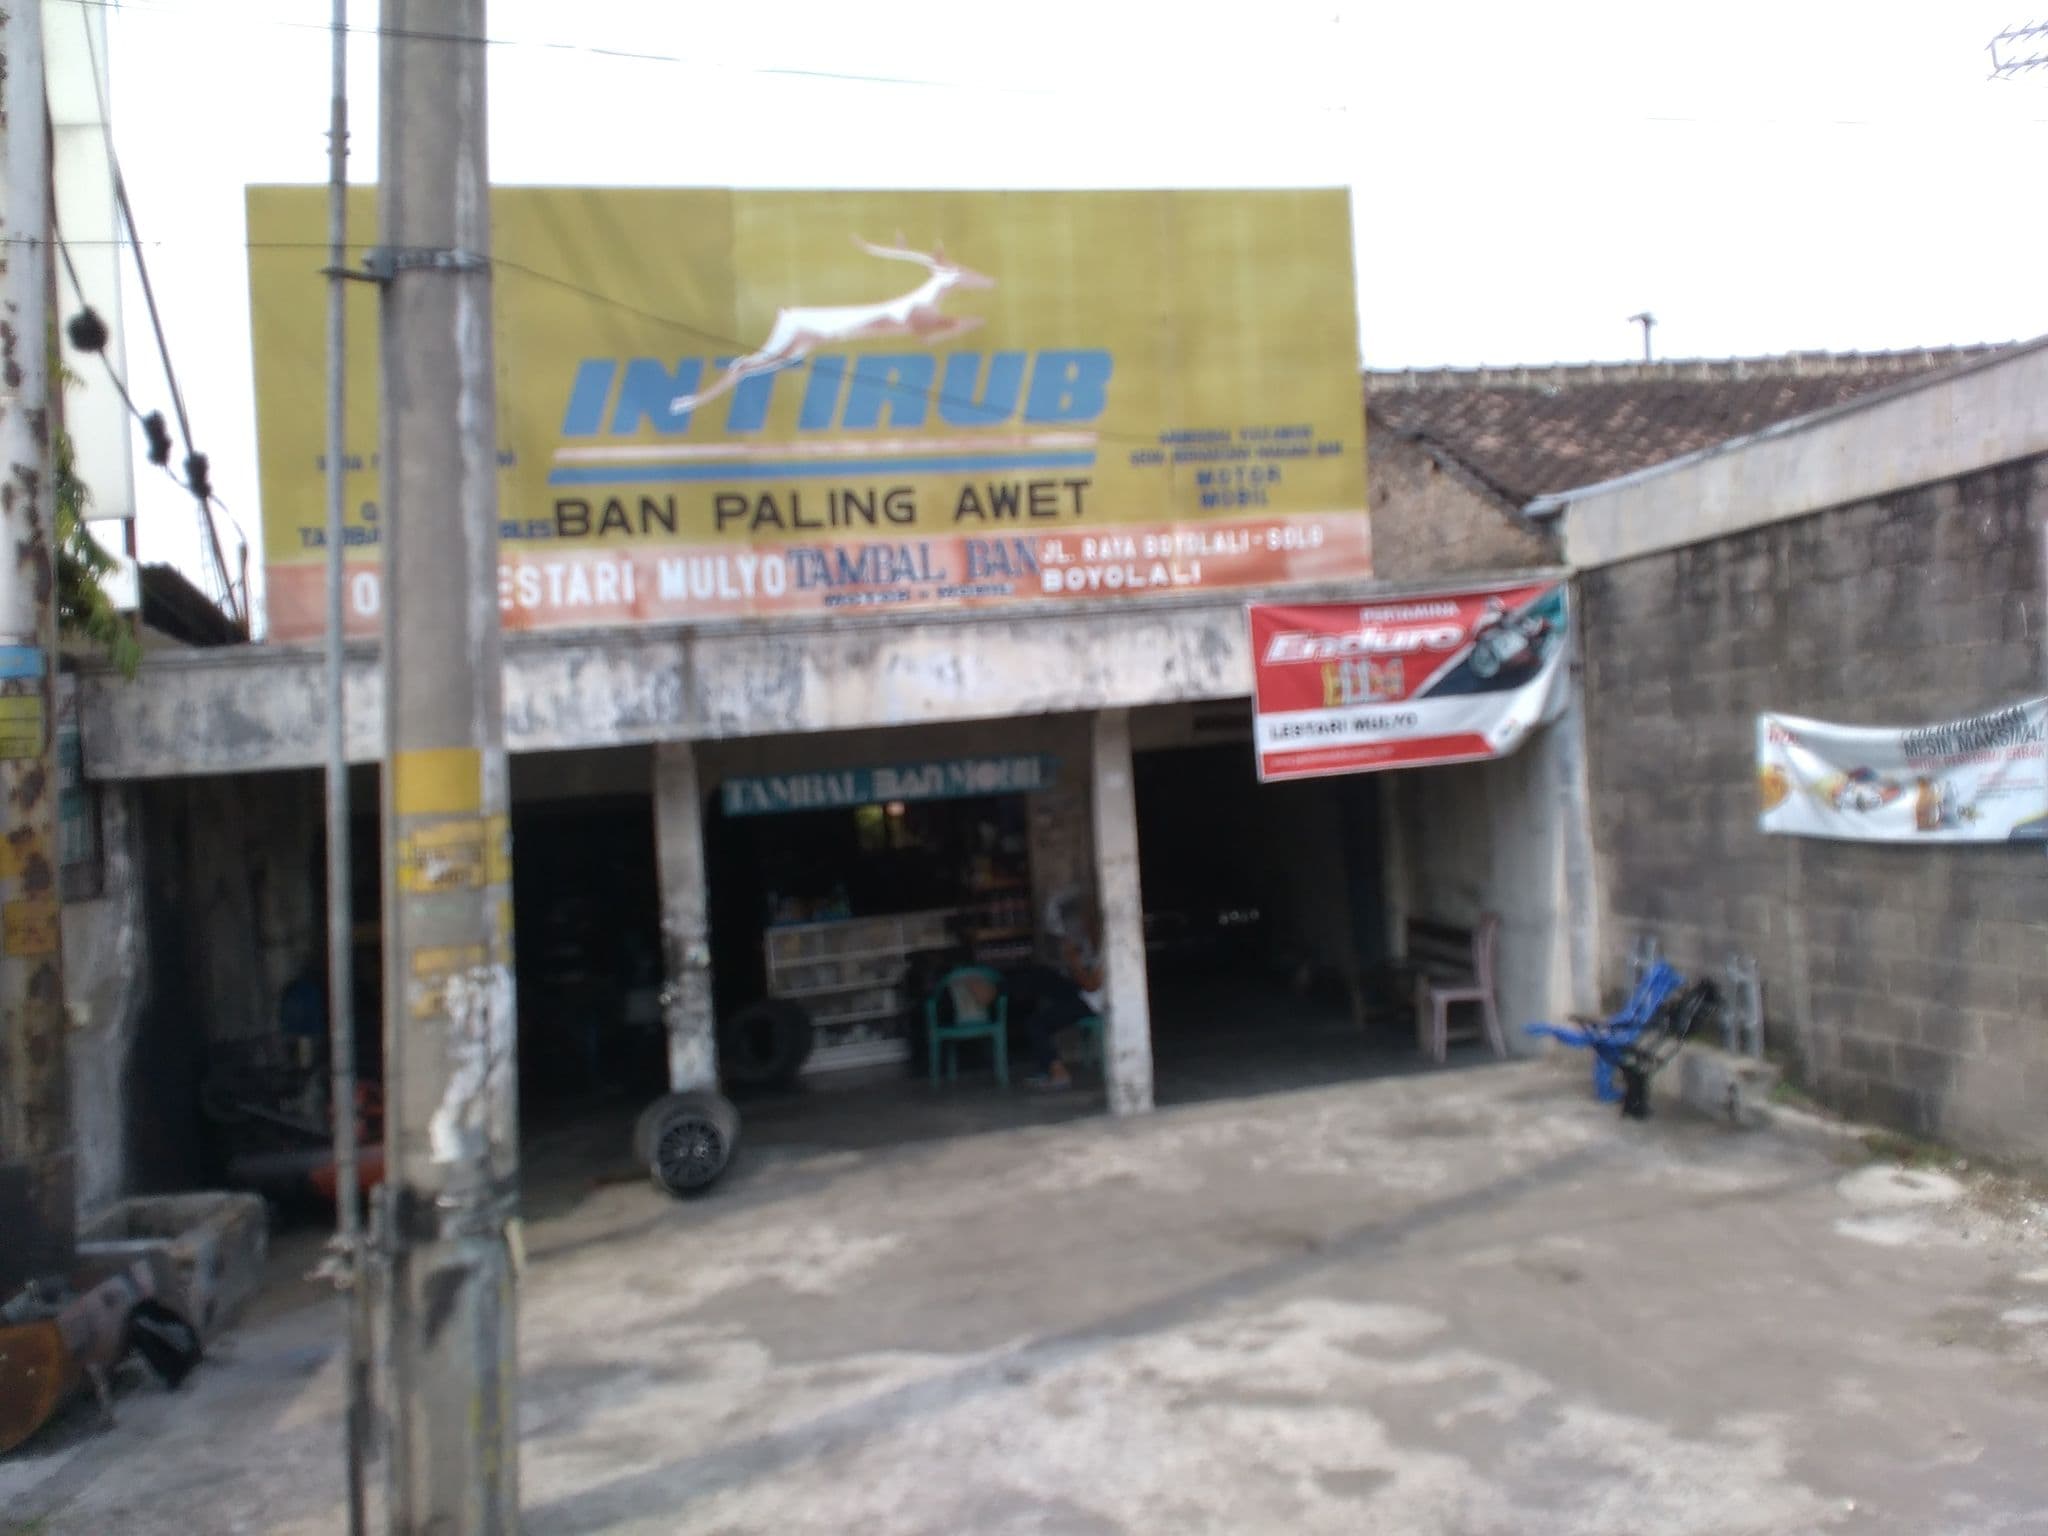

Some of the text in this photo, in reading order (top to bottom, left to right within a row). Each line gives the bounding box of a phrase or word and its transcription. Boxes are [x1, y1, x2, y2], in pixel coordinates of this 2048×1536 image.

[562, 350, 1112, 435] INTIRUB
[557, 478, 1092, 535] BAN PALING AWET
[788, 536, 1041, 589] TAMBAL BAN
[1081, 536, 1137, 561] RAYA
[657, 551, 787, 602] MULYO
[1041, 559, 1202, 592] BOYOLALI
[1264, 624, 1464, 665] Enduro
[1354, 711, 1419, 734] MULYO
